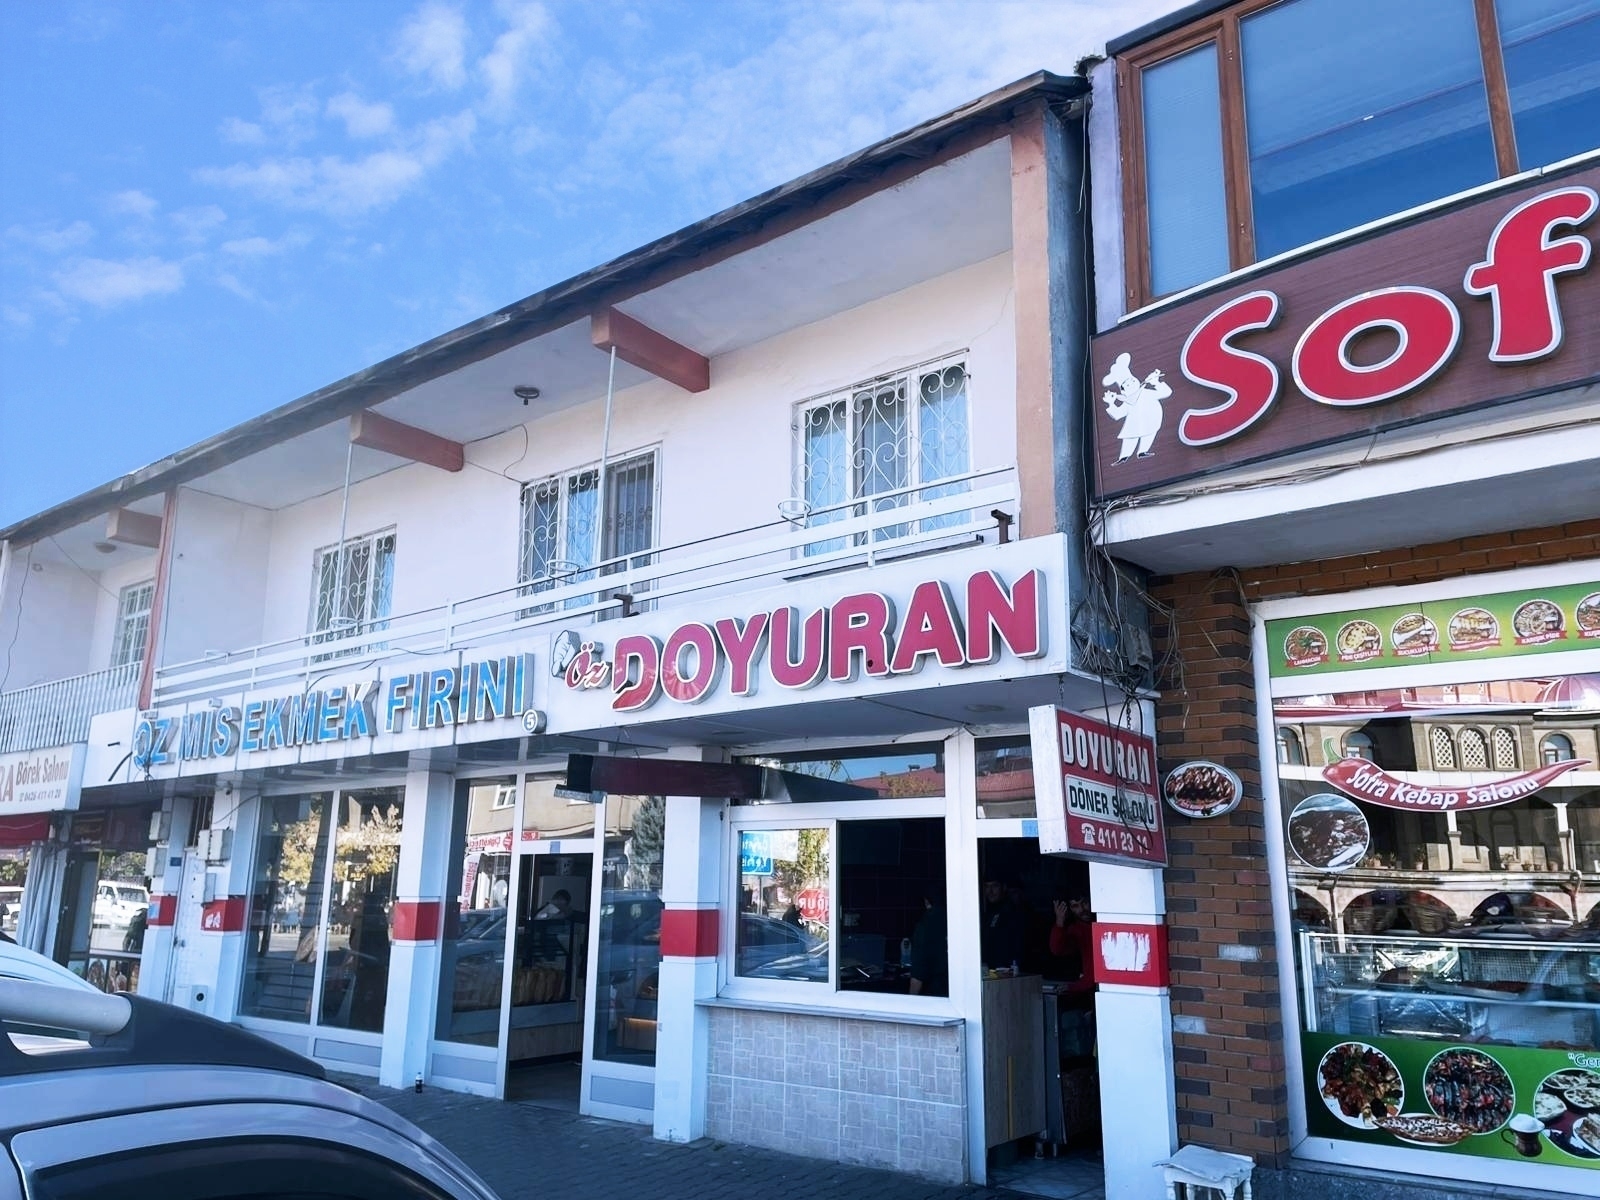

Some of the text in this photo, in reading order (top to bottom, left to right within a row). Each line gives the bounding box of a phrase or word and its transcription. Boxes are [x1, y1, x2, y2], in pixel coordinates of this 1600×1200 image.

[565, 568, 1042, 712] Öz DOYURAN
[241, 680, 376, 752] EKMEK
[384, 652, 530, 733] FIRINI
[16, 757, 41, 785] Börek
[43, 754, 69, 783] Salonu
[1060, 721, 1151, 785] DOYURAN
[1068, 781, 1110, 816] DÖNER
[1346, 764, 1540, 809] Sofra Kebap Salonu
[1098, 827, 1149, 855] 411 23 11
